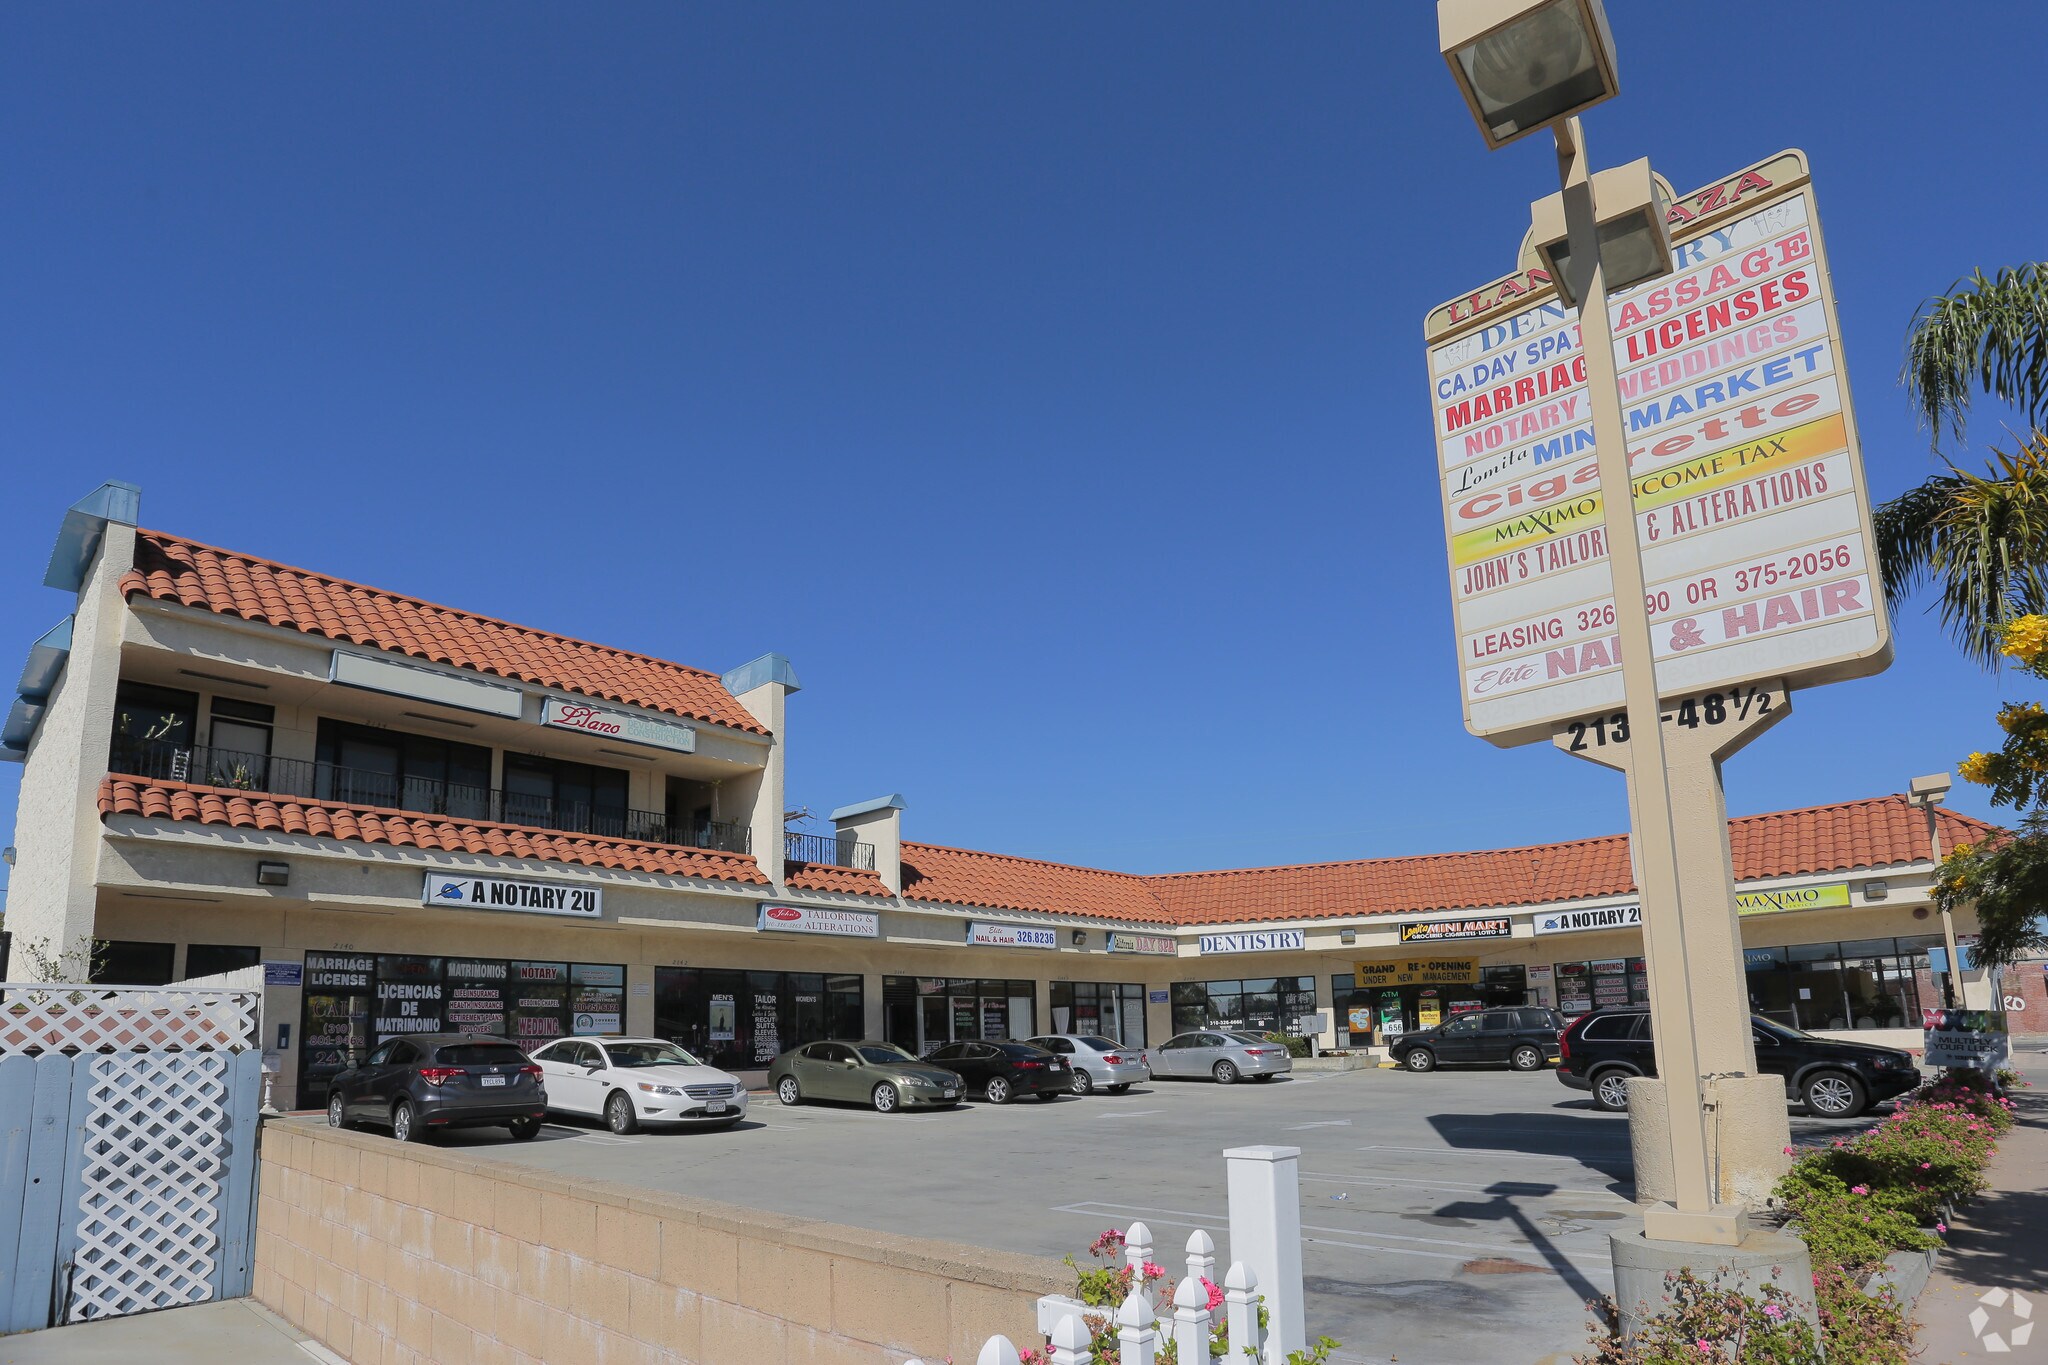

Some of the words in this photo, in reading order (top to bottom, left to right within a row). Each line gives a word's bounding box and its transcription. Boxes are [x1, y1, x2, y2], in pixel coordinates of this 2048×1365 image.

[1448, 268, 1553, 326] LLAN
[1666, 171, 1773, 223] AZA
[1438, 351, 1517, 399] CA.DAY
[1526, 331, 1572, 365] SPA
[1573, 231, 1810, 348] ASSAGE
[1446, 354, 1587, 431] MARRIAG
[1626, 271, 1809, 363] LICENSES
[1464, 395, 1578, 457] NOTARY
[1452, 450, 1528, 498] Lomita
[1495, 499, 1596, 542] MAXIMO
[1732, 437, 1787, 466] TAX
[1464, 552, 1528, 594] JOHN'S
[1646, 513, 1661, 541] &
[1672, 462, 1828, 535] ALTERATIONS
[1473, 618, 1564, 658] LEASING
[1686, 578, 1718, 604] OR
[1735, 545, 1851, 592] 375-2056
[1473, 663, 1539, 693] Elite
[1545, 636, 1623, 680] NAI
[1669, 618, 1706, 651] &
[1722, 579, 1865, 639] HAIR
[553, 706, 620, 734] Llano
[627, 719, 690, 739] DEVELOPMENT
[627, 728, 690, 746] CONSTRUCTION
[471, 881, 486, 903] A
[491, 882, 567, 910] NOTARY
[571, 890, 596, 912] 2U
[1736, 889, 1819, 909] MAXIMO
[806, 910, 863, 922] TAILORING
[1561, 915, 1570, 929] A
[1572, 909, 1625, 928] NOTARY
[804, 922, 874, 934] ALTERATIONS
[1427, 923, 1462, 934] MINI
[1463, 919, 1508, 932] MART
[976, 935, 992, 943] NAIL
[999, 936, 1015, 944] HAIR
[1017, 930, 1055, 945] 326.8236
[1136, 937, 1156, 952] DAY
[1157, 938, 1176, 953] SPA
[1200, 932, 1303, 952] DENTISTRY
[333, 942, 354, 950] 2140
[306, 957, 373, 970] MARRIAGE
[448, 963, 507, 978] MATRIMONIOS
[1362, 965, 1395, 974] GRAND
[1408, 962, 1419, 971] RE
[1428, 961, 1471, 970] OPENING
[1594, 962, 1624, 971] WEDDINGS
[311, 973, 367, 986] LICENSE
[521, 967, 558, 979] NOTARY
[1363, 975, 1387, 984] UNDER
[1397, 973, 1413, 982] NEW
[1422, 972, 1471, 981] MANAGEMENT
[378, 984, 442, 999] LICENCIAS
[453, 989, 467, 998] LIFE
[467, 989, 499, 998] INSURANCE
[754, 994, 777, 1004] TAILOR
[312, 1000, 364, 1018] CALL
[401, 1001, 418, 1016] DE
[449, 1001, 471, 1009] HEALTH
[471, 1001, 503, 1009] INSURANCE
[376, 1018, 440, 1032] MATRIMONIO
[449, 1013, 484, 1022] RETIREMENT
[485, 1013, 503, 1022] PLANS
[460, 1025, 491, 1033] ROLLOVERS
[518, 1017, 559, 1035] WEDDING
[1934, 1043, 1964, 1051] YOUR
[1968, 1044, 1999, 1053] LUCK
[1938, 1037, 1991, 1045] MULTIPLY
